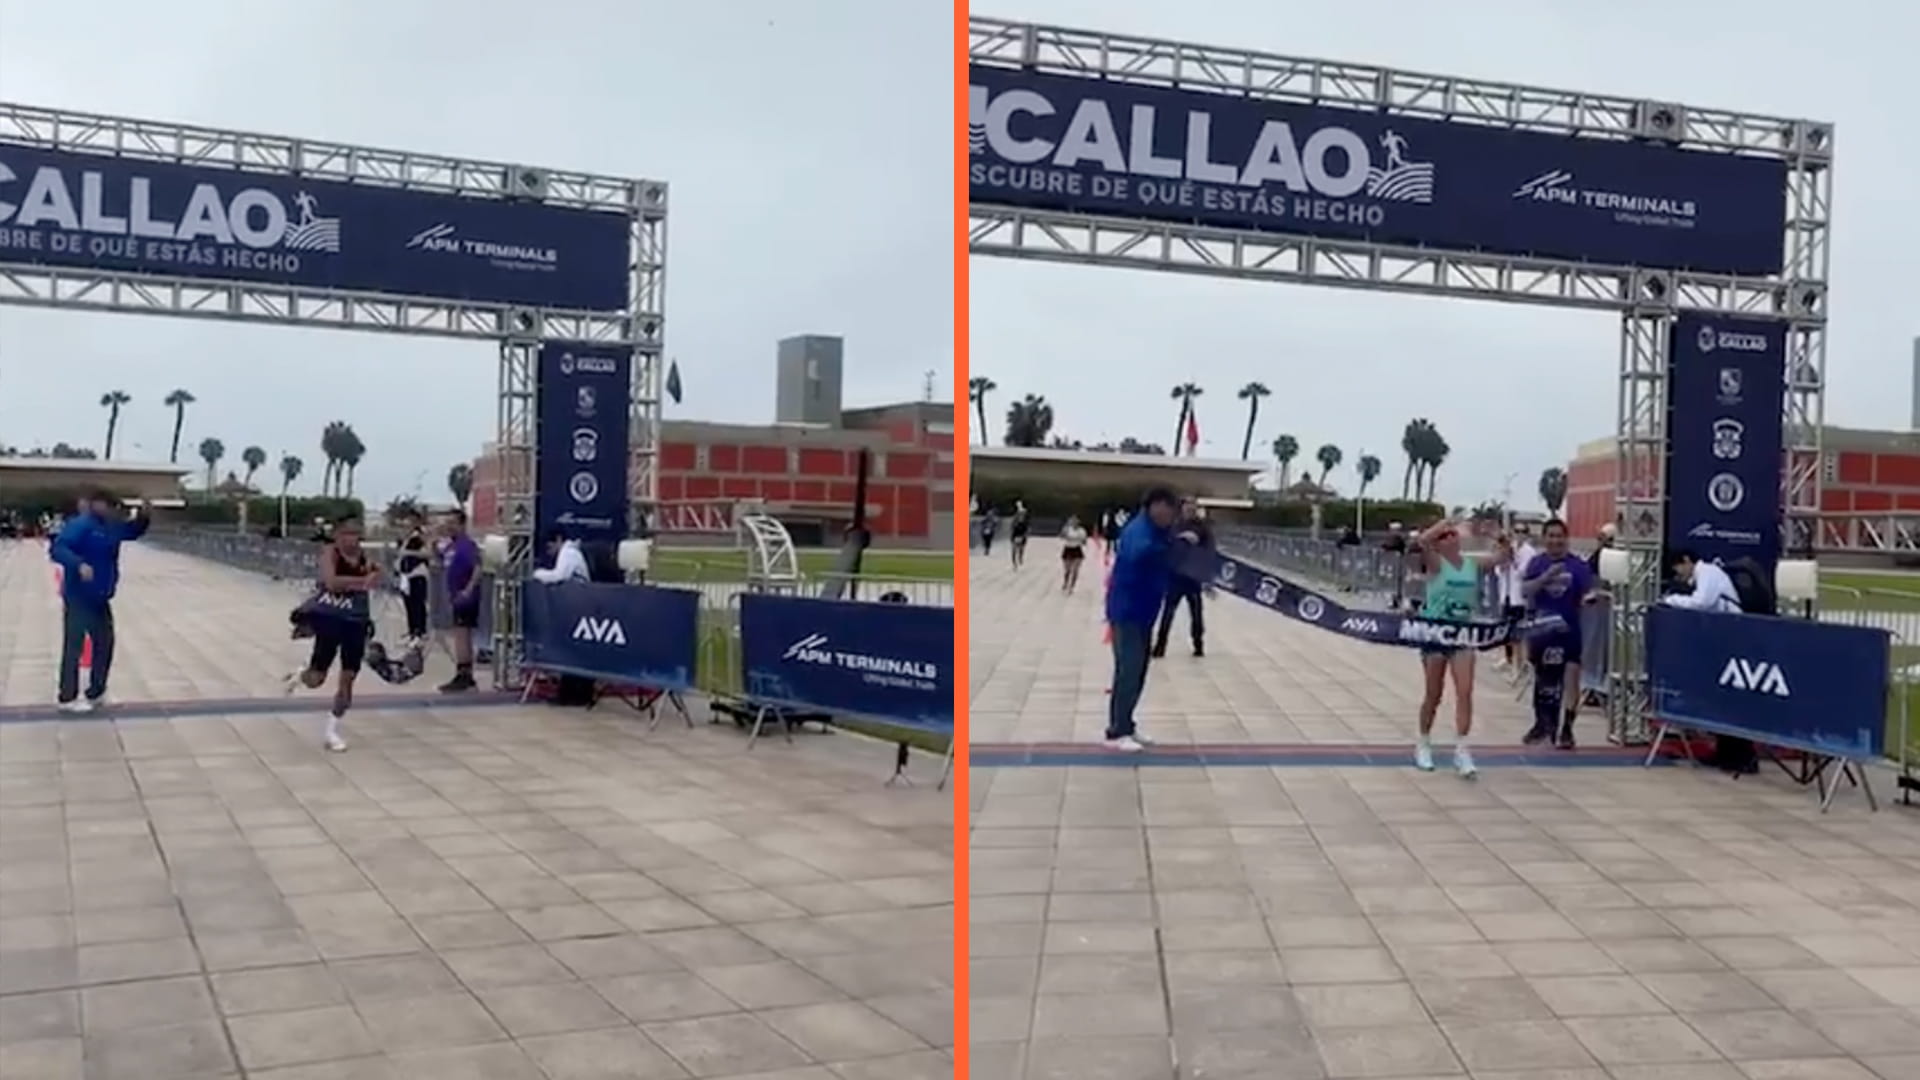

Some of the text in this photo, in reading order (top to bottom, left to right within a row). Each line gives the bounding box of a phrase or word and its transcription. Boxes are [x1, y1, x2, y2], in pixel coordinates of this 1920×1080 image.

[969, 163, 1385, 226] SCUBRE DE QUÉ ESTÁS HECHO
[1533, 186, 1696, 215] APM TERMINALS
[51, 232, 82, 254] DE
[90, 235, 138, 258] QUÉ
[146, 242, 216, 266] ESTÁS
[223, 247, 301, 273] HECHO
[423, 236, 557, 262] APM TERMINALS
[318, 592, 354, 609] AVA
[572, 616, 627, 646] AVA
[797, 647, 937, 678] APM TERMINALS
[1719, 657, 1791, 697] AVA
